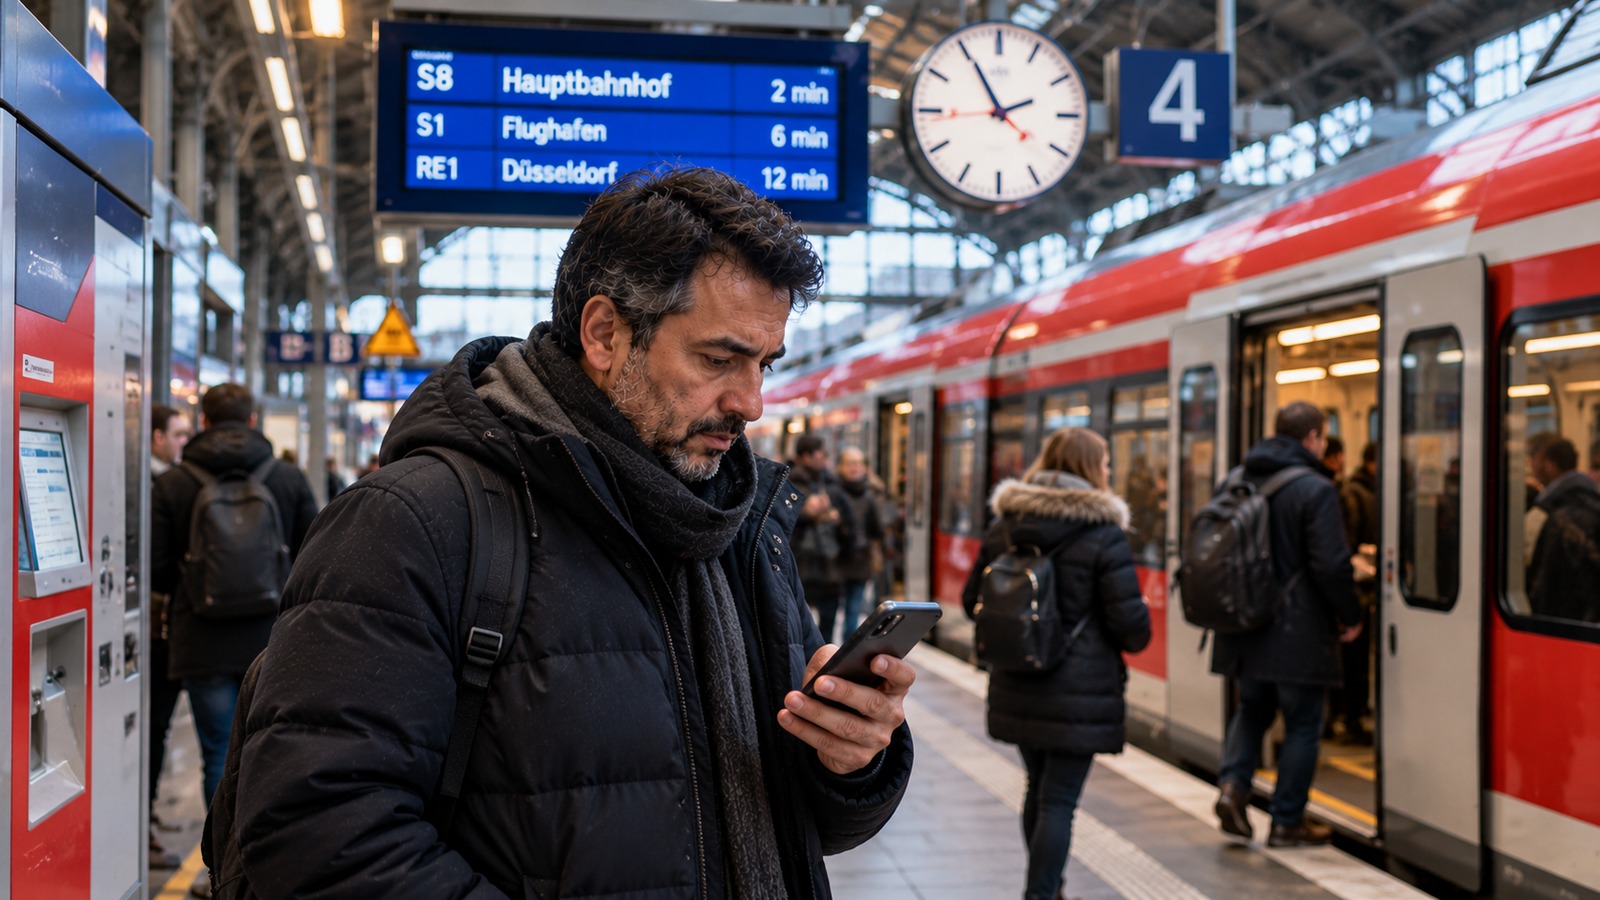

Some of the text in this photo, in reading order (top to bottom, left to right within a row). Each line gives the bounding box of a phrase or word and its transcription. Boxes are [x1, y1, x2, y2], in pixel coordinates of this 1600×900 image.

[417, 63, 829, 104] S8 Hauptbahnhof 2 min
[1149, 59, 1205, 142] 4
[417, 112, 828, 149] S1 Flughafen 6 min
[416, 155, 829, 191] RE1 Düsseldorf 12 min
